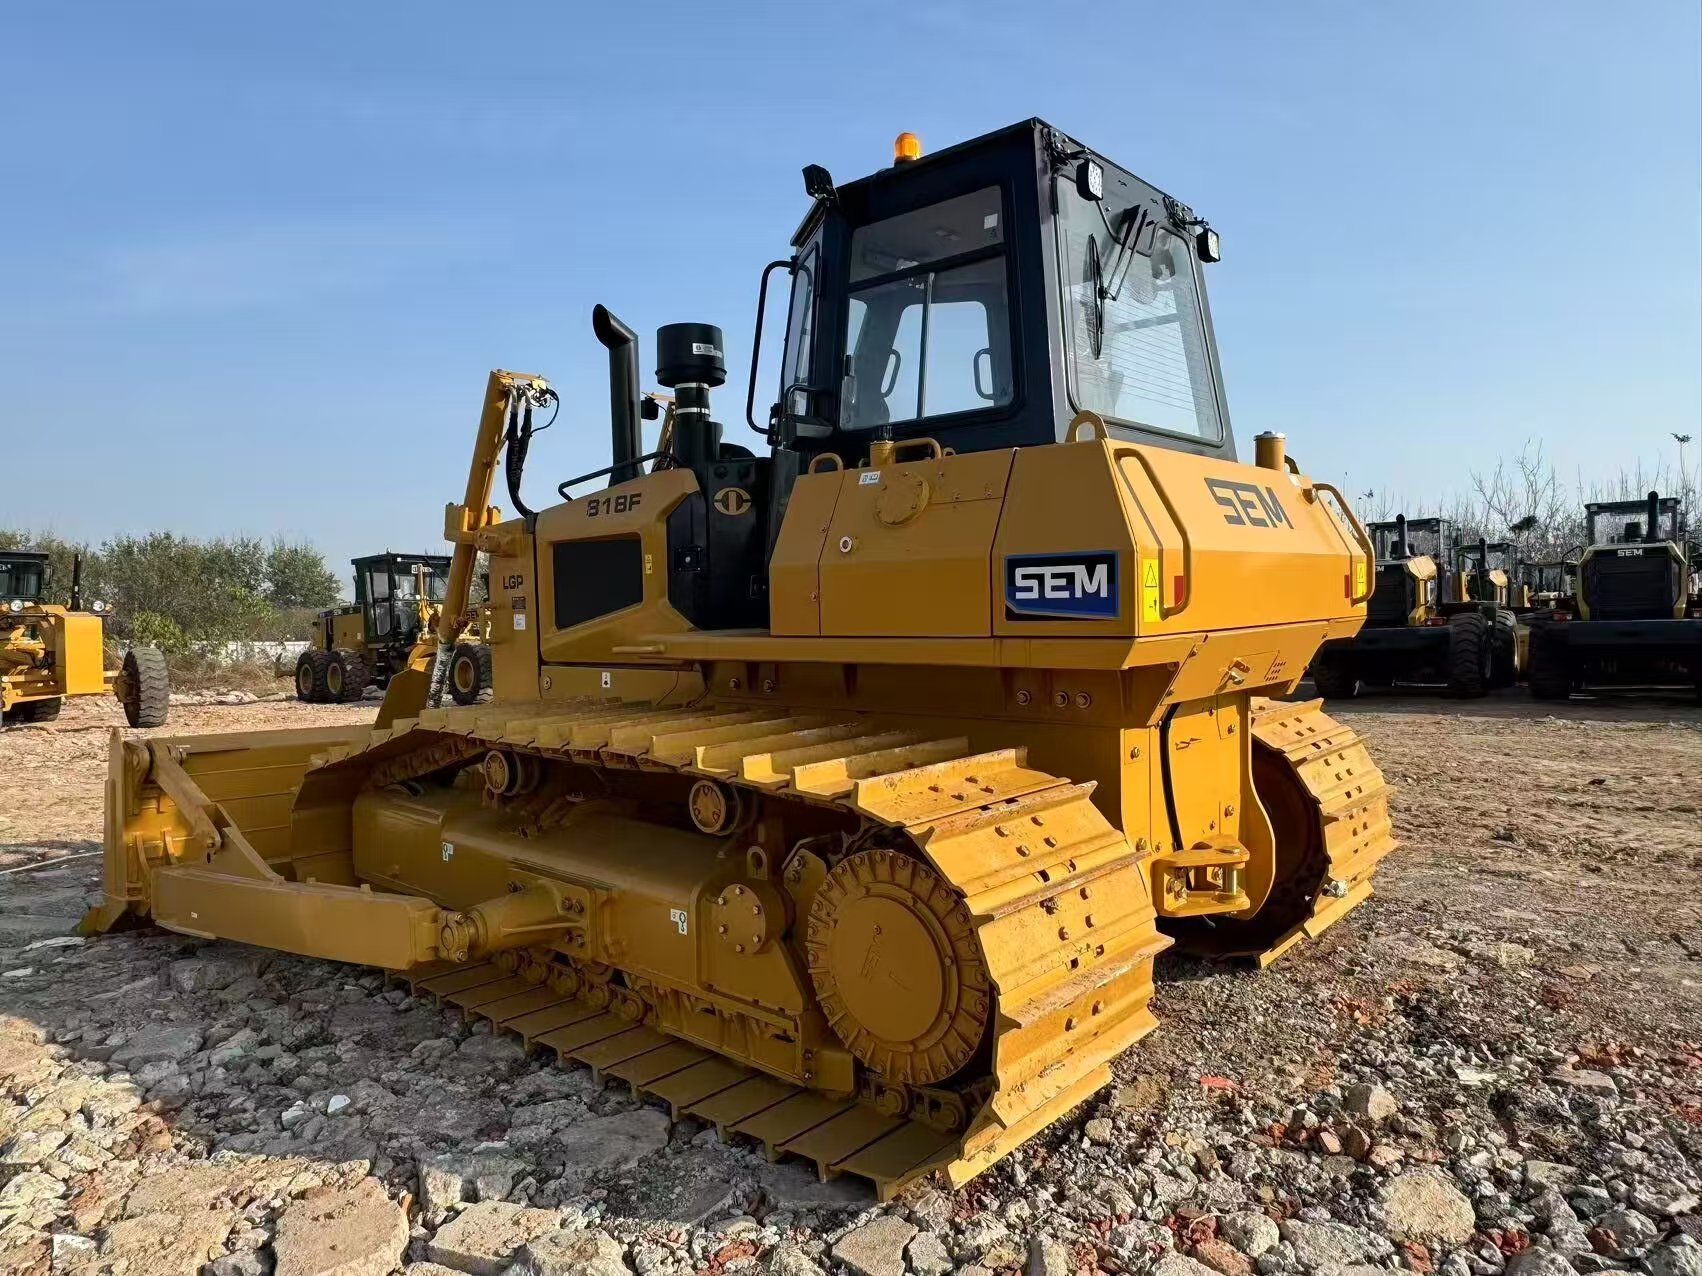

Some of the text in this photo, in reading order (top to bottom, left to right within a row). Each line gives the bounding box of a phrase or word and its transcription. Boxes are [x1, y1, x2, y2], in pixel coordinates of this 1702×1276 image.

[587, 492, 642, 517] 818F
[1204, 477, 1294, 529] SEM
[1617, 549, 1643, 557] SEM
[503, 575, 523, 589] LGP
[1015, 563, 1108, 599] SEM
